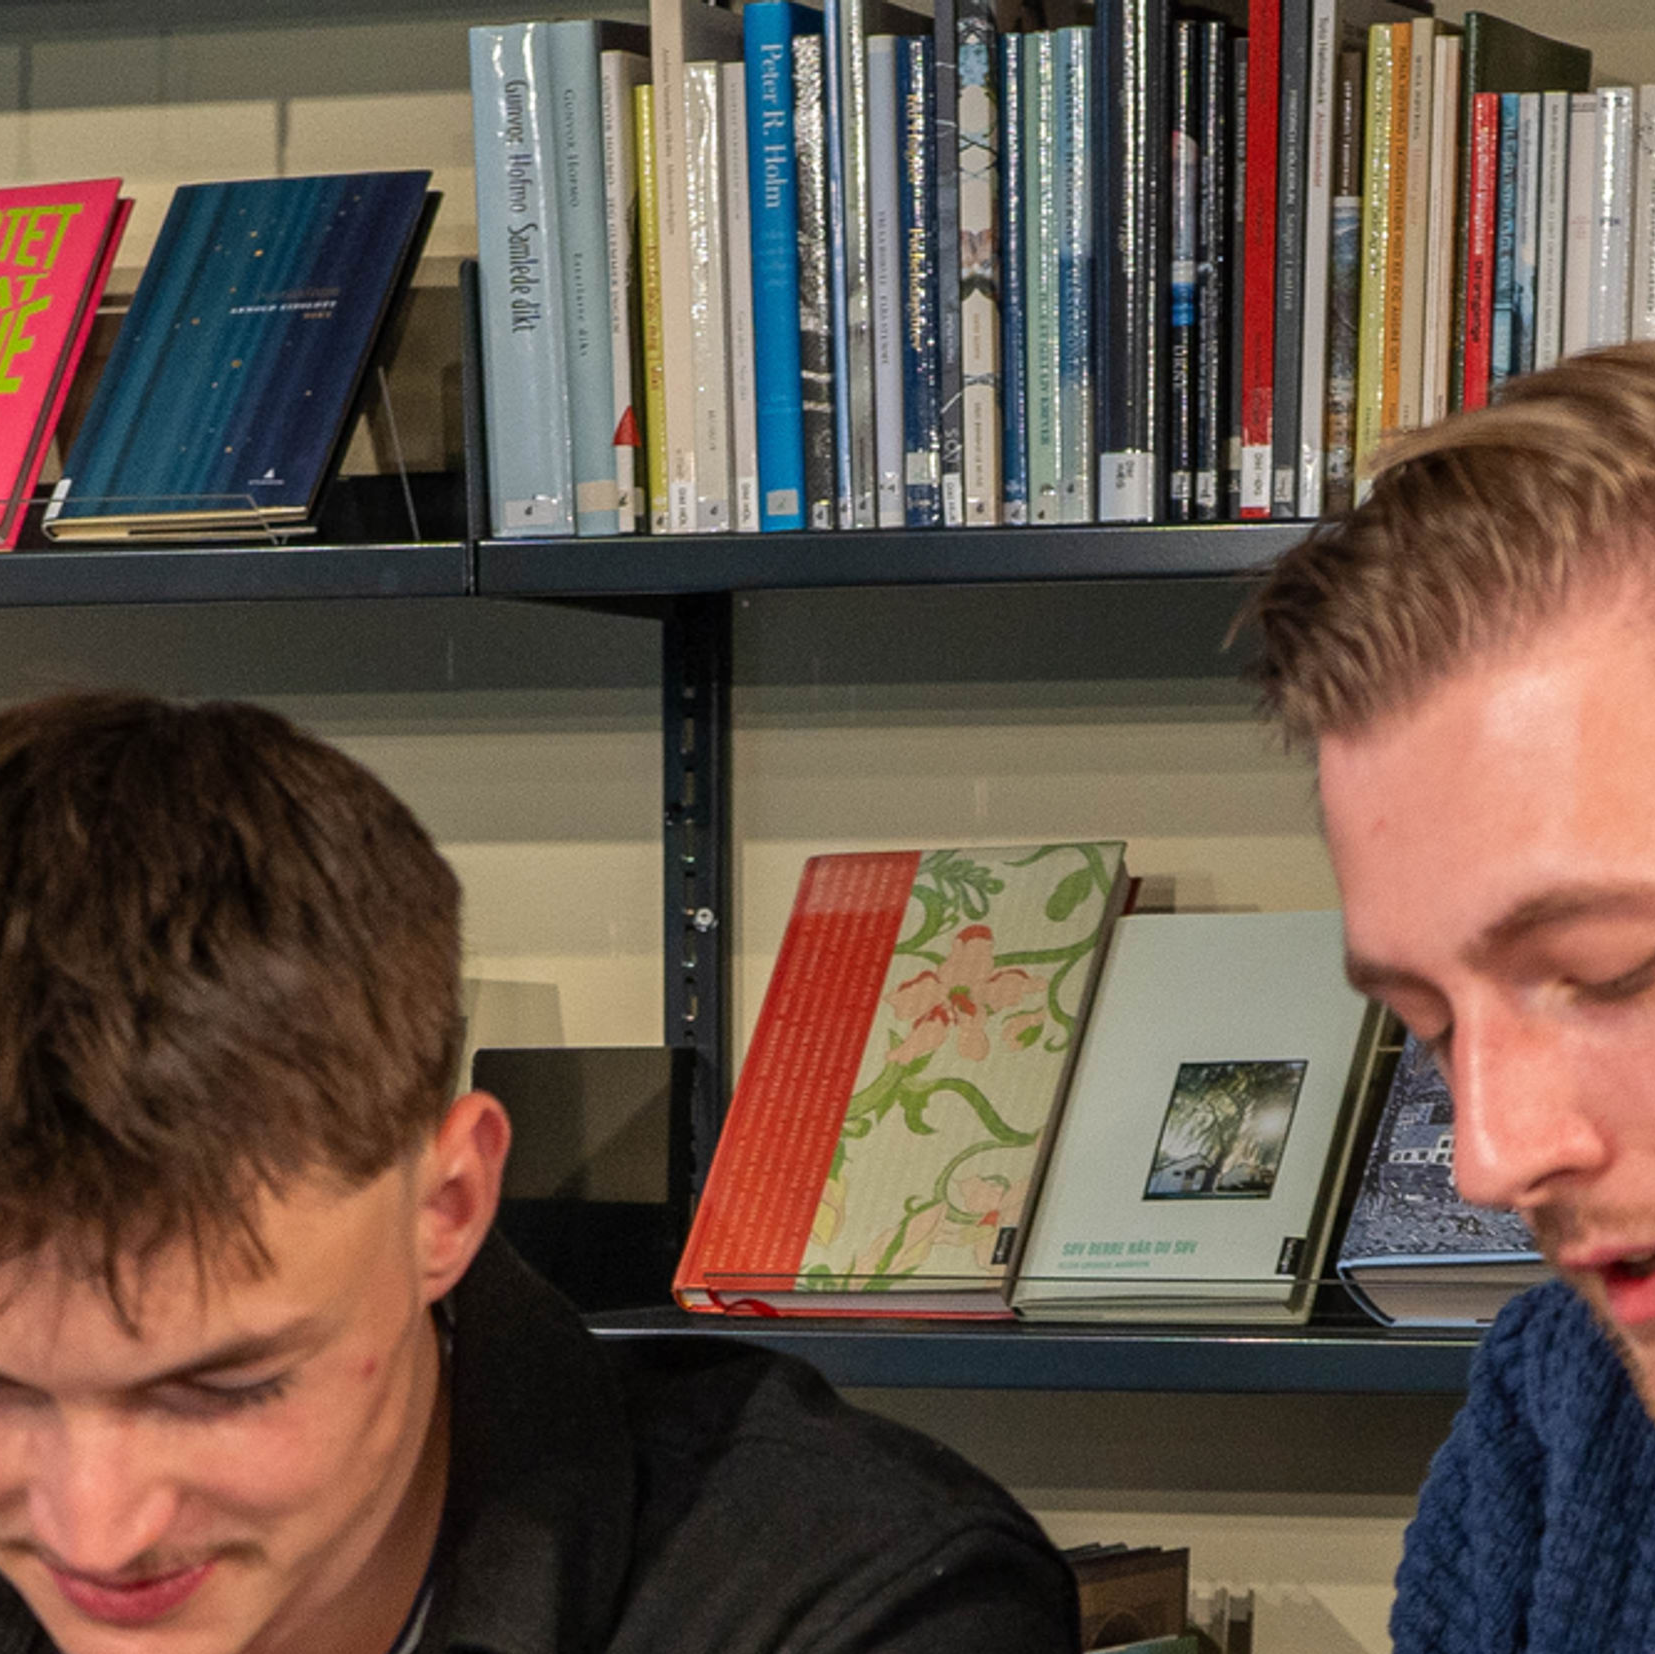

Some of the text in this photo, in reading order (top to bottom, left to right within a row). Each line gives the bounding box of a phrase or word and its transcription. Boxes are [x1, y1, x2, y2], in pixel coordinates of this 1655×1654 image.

[759, 45, 788, 209] Peter R. Holm
[506, 153, 535, 214] Hofmo
[507, 221, 541, 294] Samlede
[510, 298, 542, 334] dikt
